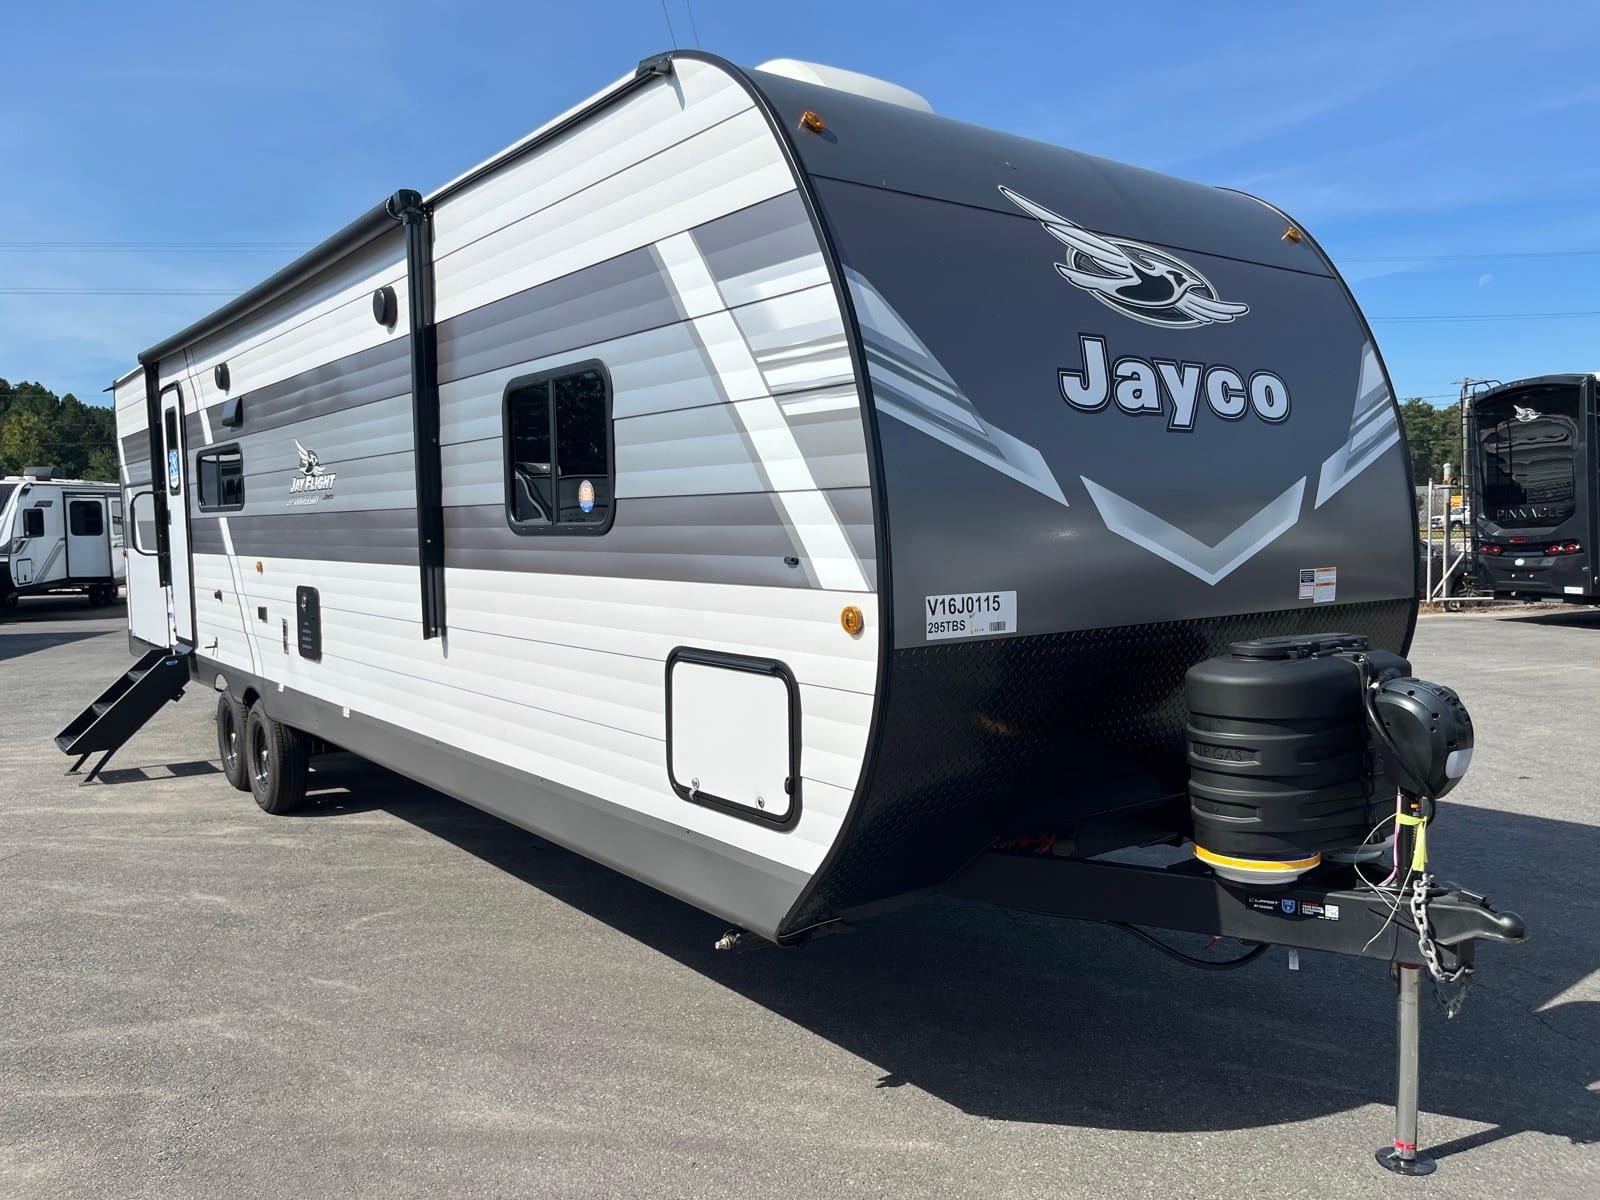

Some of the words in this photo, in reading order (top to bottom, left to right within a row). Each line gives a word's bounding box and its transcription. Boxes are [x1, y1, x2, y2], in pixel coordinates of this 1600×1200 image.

[1057, 332, 1292, 433] Jayco
[290, 476, 306, 494] JAY
[305, 473, 336, 492] FLIGHT
[927, 595, 1000, 616] V16J0115
[928, 620, 966, 634] 295TBS
[1213, 747, 1242, 761] GAS
